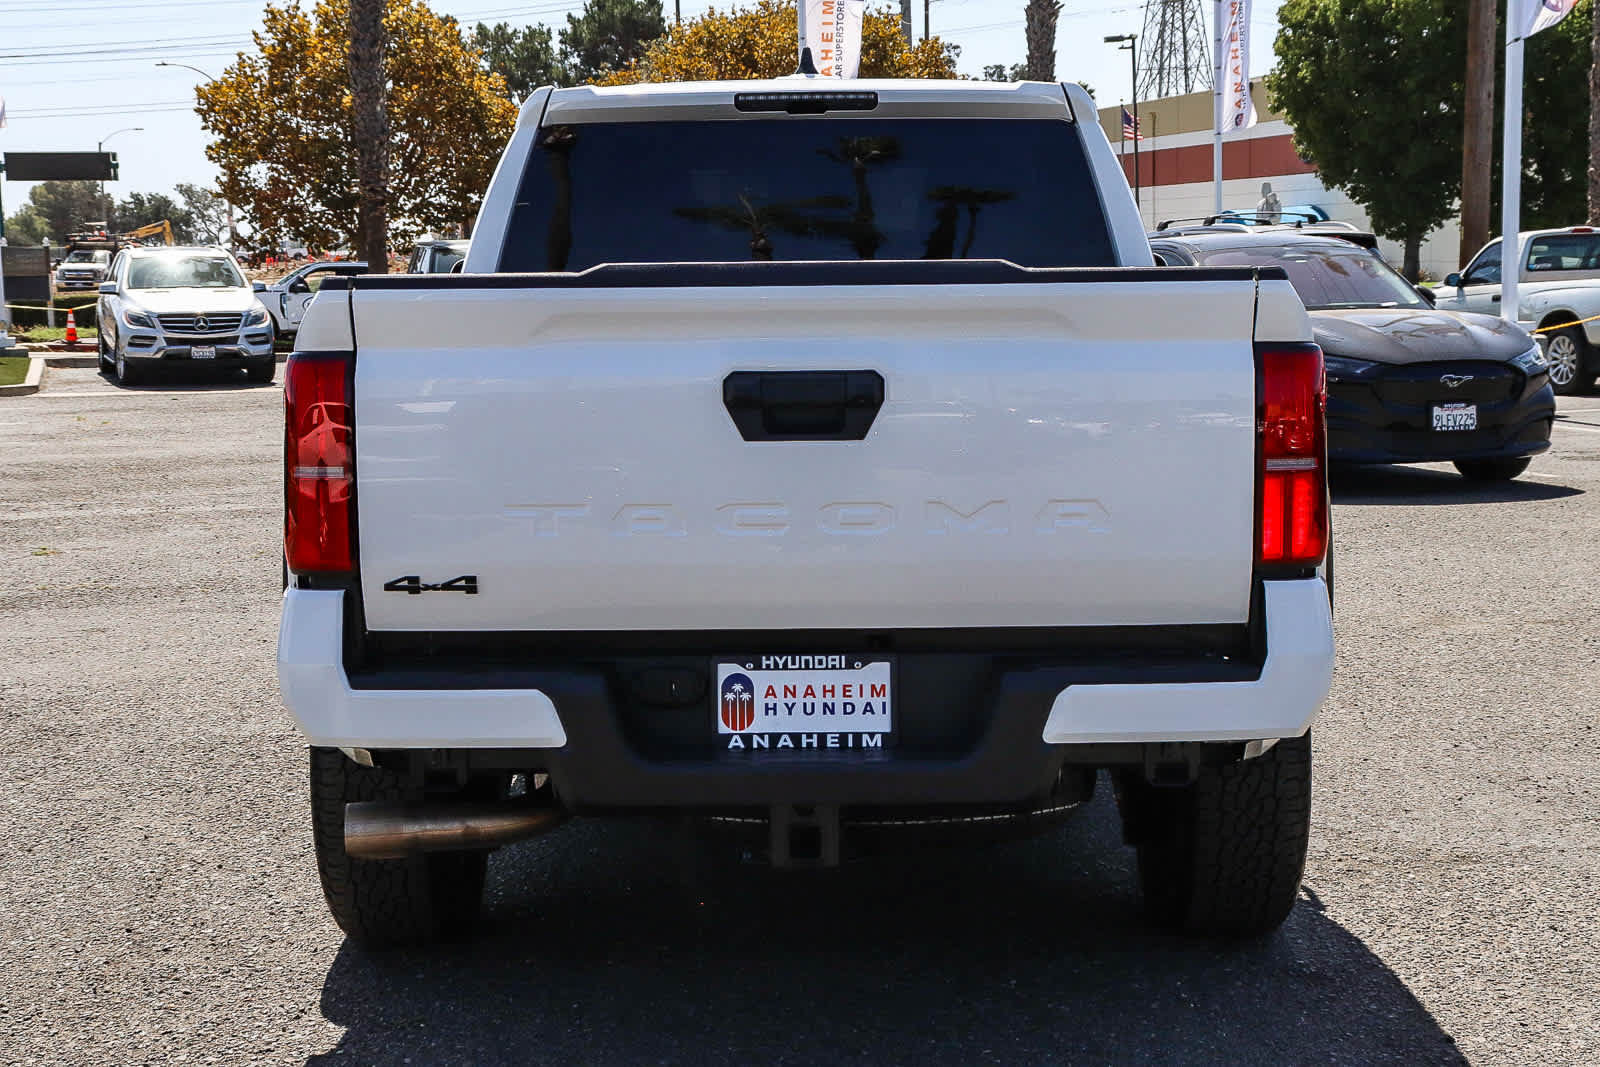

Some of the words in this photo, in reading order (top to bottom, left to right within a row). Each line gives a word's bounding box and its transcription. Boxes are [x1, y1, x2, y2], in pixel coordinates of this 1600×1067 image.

[821, 0, 834, 76] AHEIM
[835, 0, 845, 62] SUPERSTORE
[835, 64, 843, 79] AR
[503, 498, 1112, 536] TACOMA
[383, 575, 477, 594] 4x4
[762, 655, 846, 669] HYUNDAI
[764, 684, 887, 699] ANAHEIM
[764, 701, 887, 716] HYUNDAI
[728, 733, 882, 749] ANAHEIM
